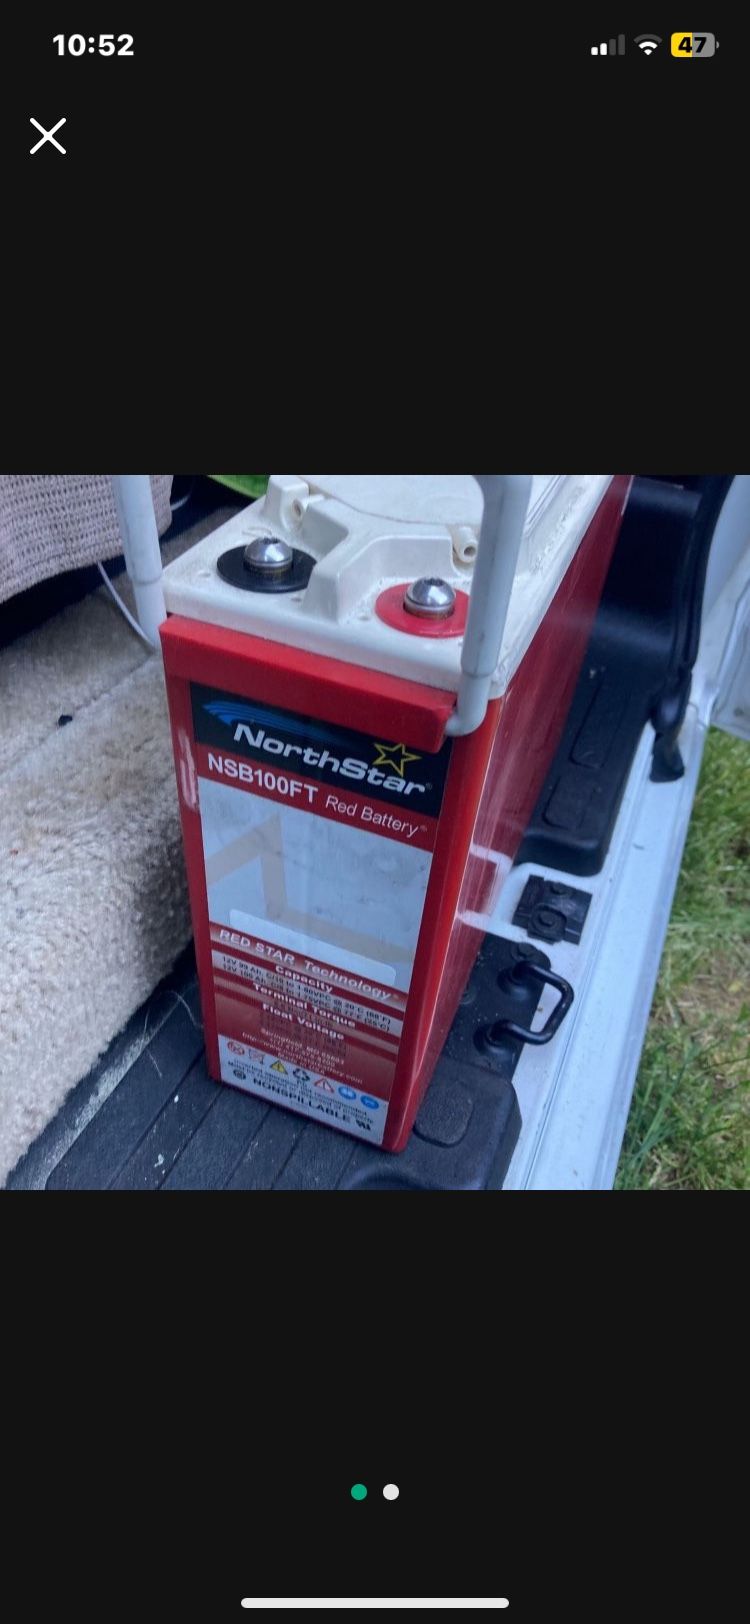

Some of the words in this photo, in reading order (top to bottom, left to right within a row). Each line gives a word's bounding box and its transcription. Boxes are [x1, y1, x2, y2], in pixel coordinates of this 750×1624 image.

[233, 723, 426, 796] NorthStar
[207, 752, 319, 804] NSB100FT
[325, 795, 357, 818] Red
[360, 807, 419, 839] Battery
[219, 929, 250, 949] RED
[254, 941, 295, 965] STAR
[304, 960, 391, 1001] Technology
[275, 965, 333, 994] Capacity
[253, 982, 307, 1010] Terminal
[311, 1004, 356, 1028] Torque
[263, 1003, 292, 1022] Float
[297, 1016, 344, 1041] Voltage
[253, 1077, 351, 1122] NONSPILLABLE
